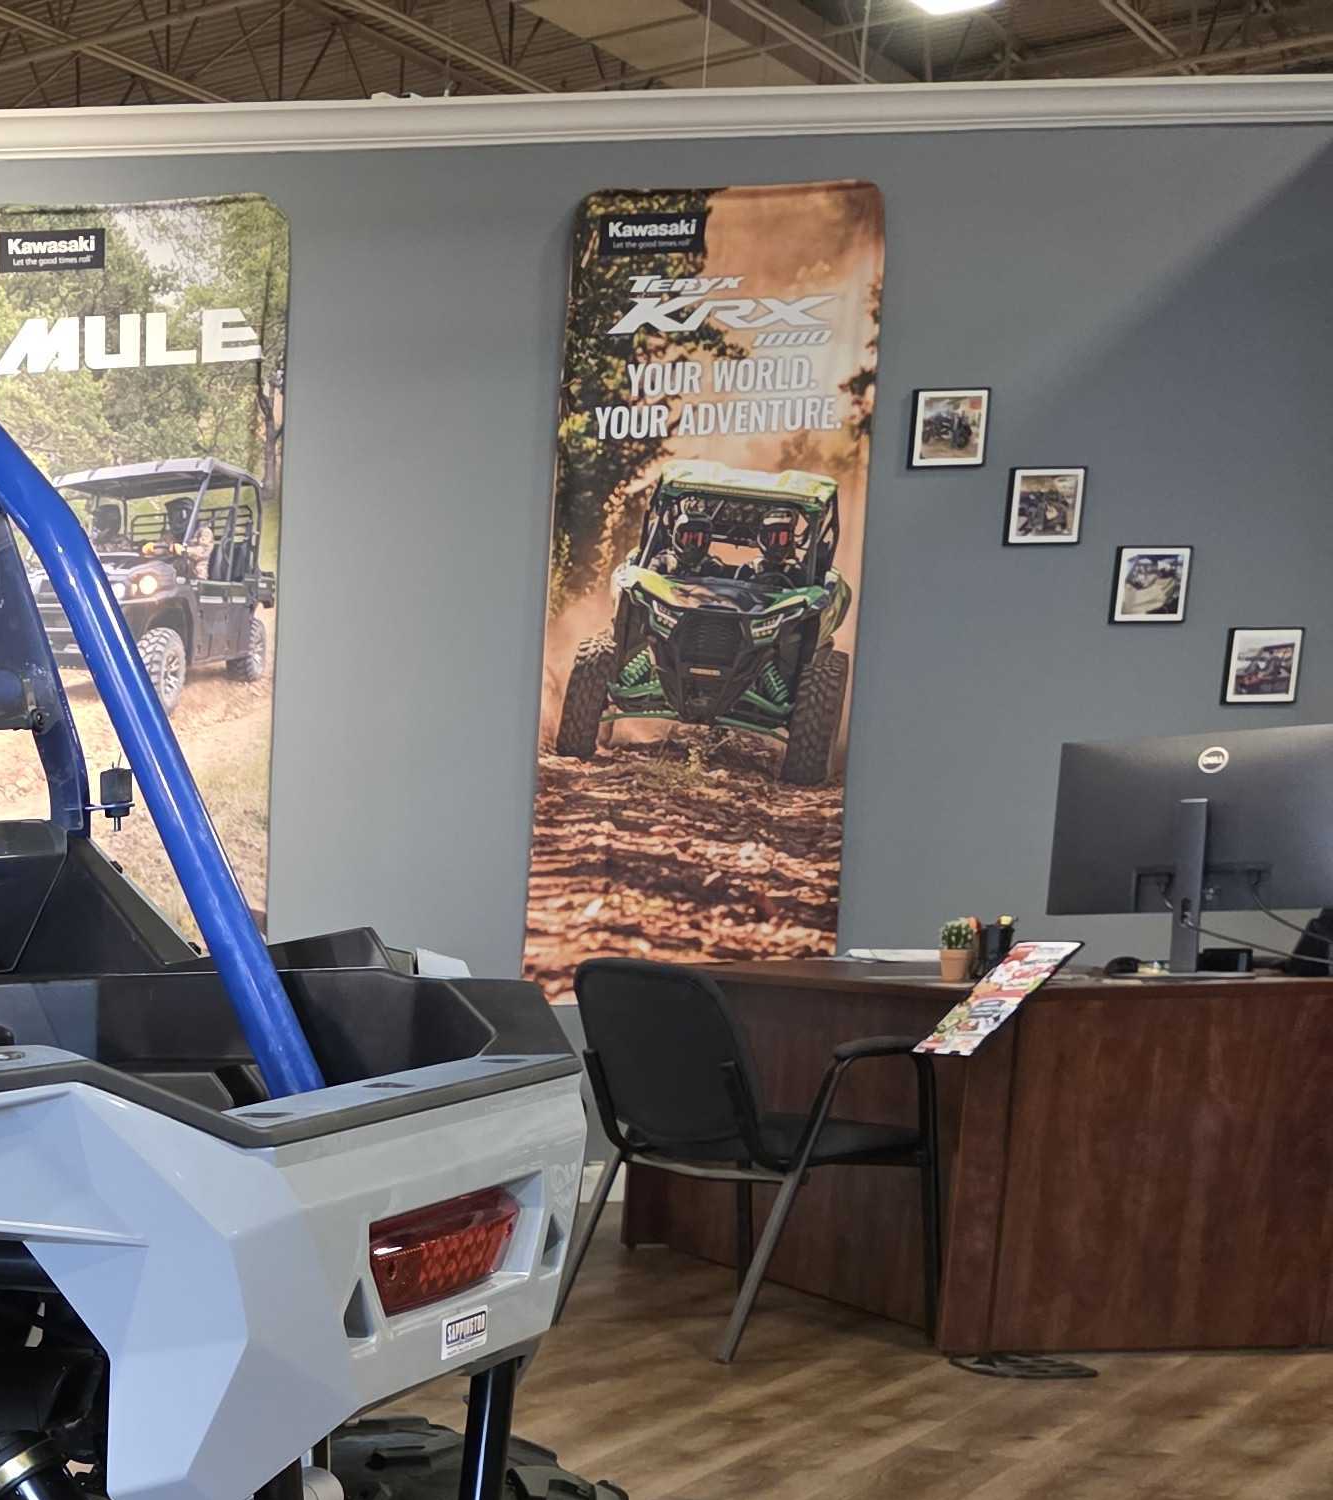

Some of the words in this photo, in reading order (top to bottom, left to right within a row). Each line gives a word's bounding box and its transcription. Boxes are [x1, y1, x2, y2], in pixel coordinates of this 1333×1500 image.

[608, 218, 697, 238] Kawasaki
[7, 235, 96, 255] Kawasaki
[12, 258, 24, 267] Let
[25, 257, 38, 266] the
[39, 256, 58, 267] good
[628, 275, 745, 294] TERYX
[606, 294, 838, 335] KRX
[752, 331, 832, 348] 1000
[627, 360, 703, 398] YOUR
[712, 356, 818, 394] WORLD.
[595, 404, 669, 440] YOUR
[678, 397, 843, 437] ADVENTURE.
